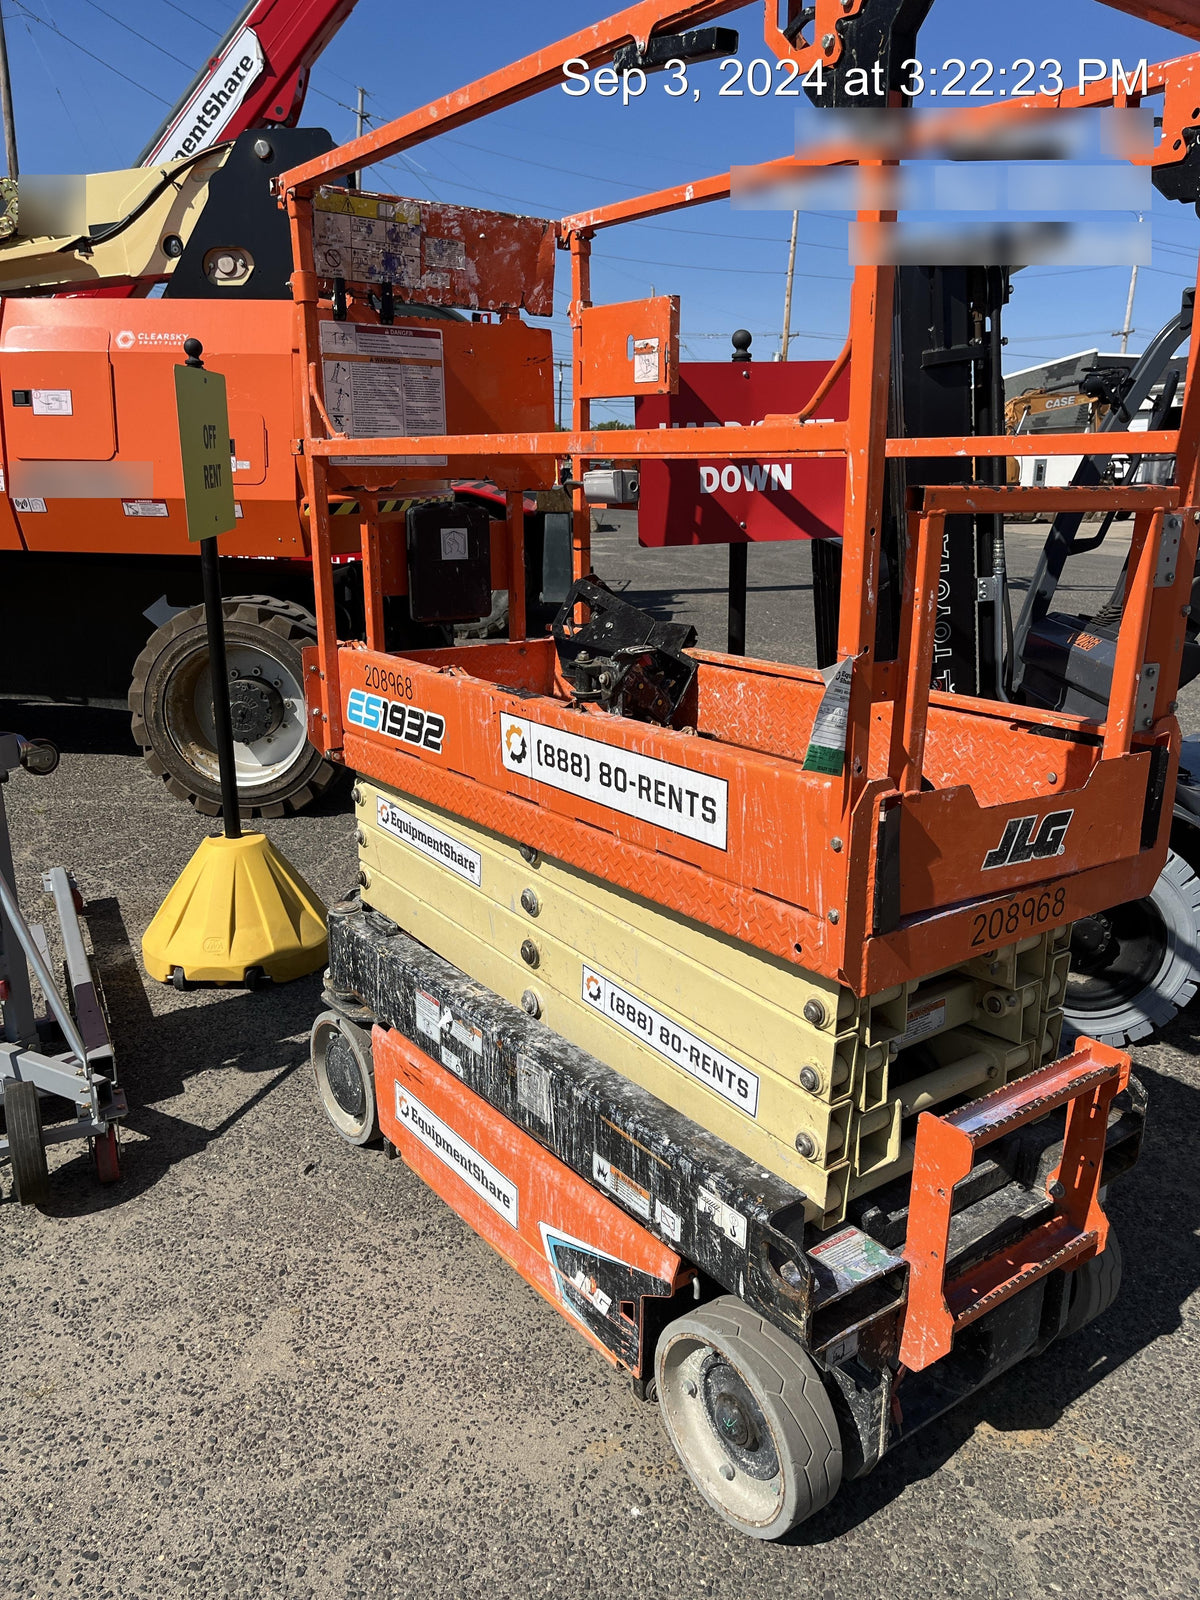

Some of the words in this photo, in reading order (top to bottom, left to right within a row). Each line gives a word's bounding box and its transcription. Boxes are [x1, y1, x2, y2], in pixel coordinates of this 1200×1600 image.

[137, 332, 189, 341] CLEARSKY
[1045, 395, 1076, 409] CASE
[203, 424, 217, 450] OFF
[203, 464, 222, 490] RENT
[700, 463, 792, 494] DOWN
[364, 664, 414, 701] 208968
[347, 688, 446, 753] ES1932
[536, 738, 591, 783] (888)
[599, 761, 717, 825] 80-RENTS
[390, 809, 476, 874] EquipmentShare
[980, 808, 1075, 871] JLG
[971, 887, 1066, 947] 208968
[610, 991, 653, 1036] (888)
[659, 1025, 749, 1100] 80-RENTS
[410, 1105, 512, 1210] EquipmentShare
